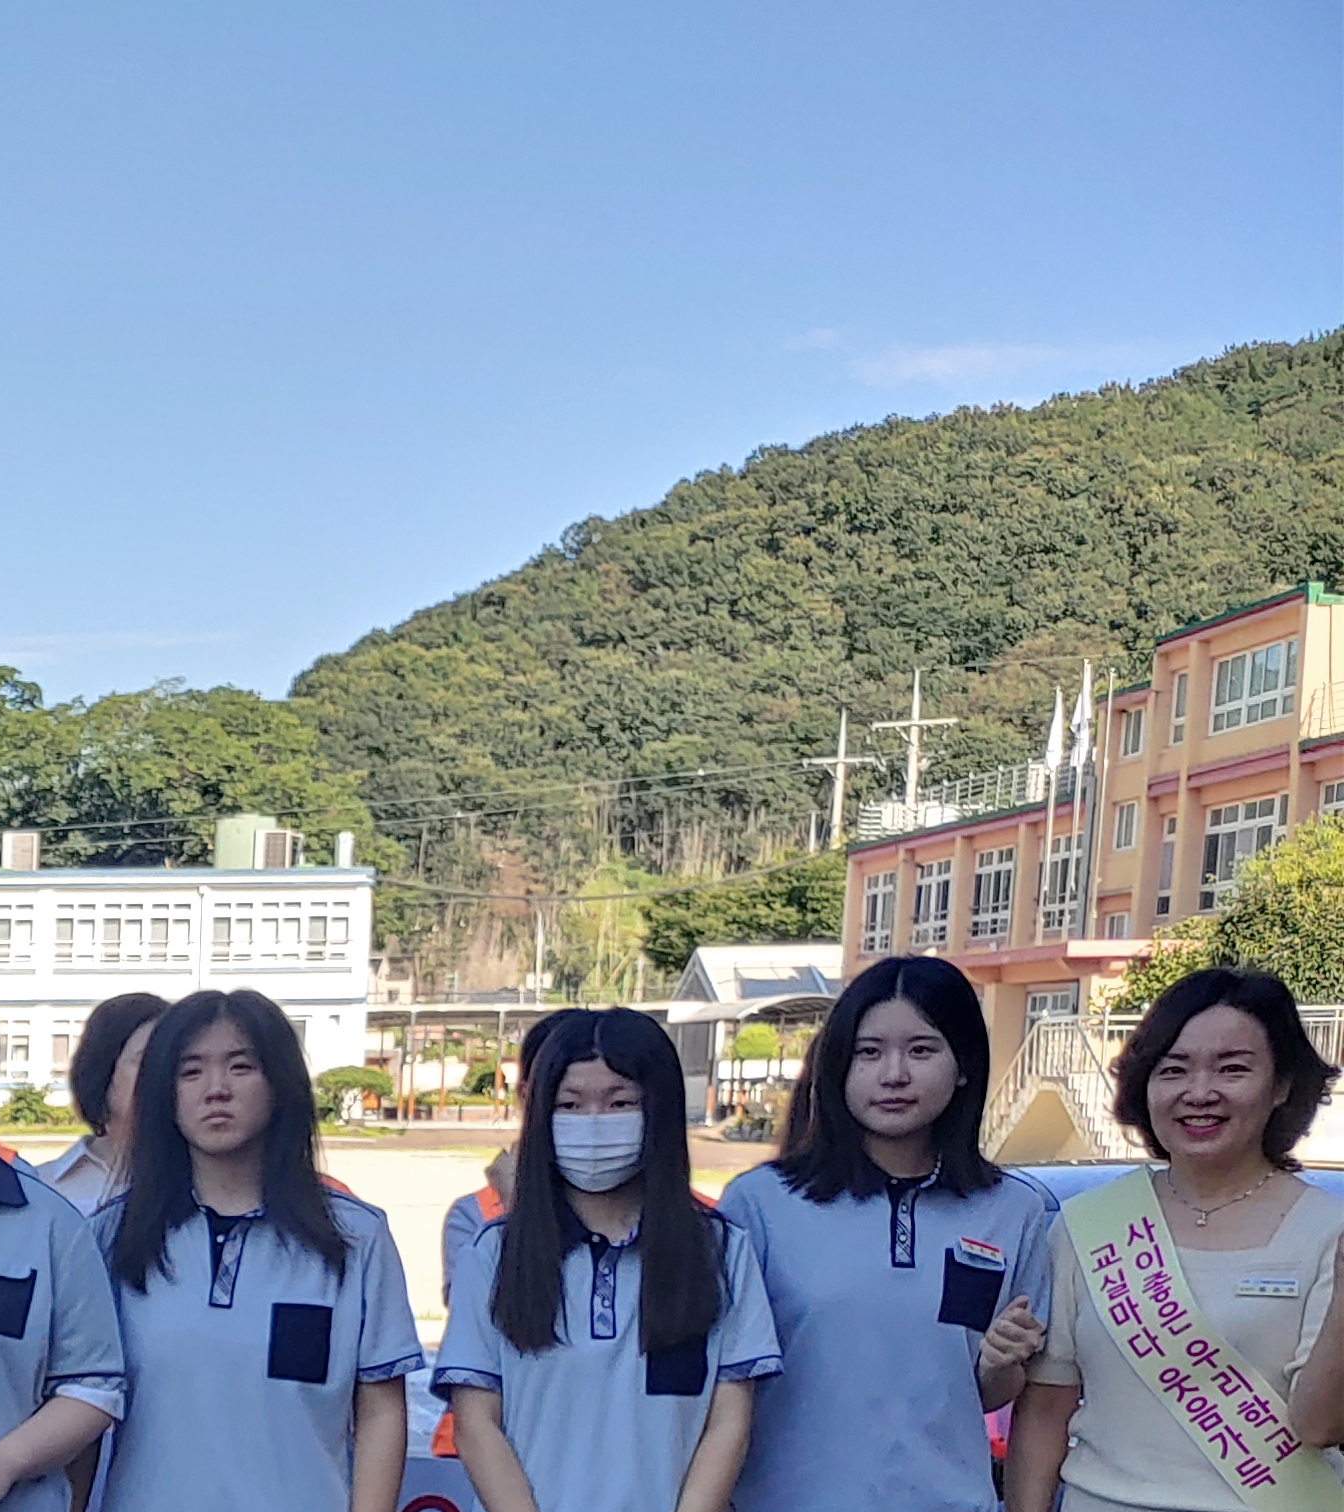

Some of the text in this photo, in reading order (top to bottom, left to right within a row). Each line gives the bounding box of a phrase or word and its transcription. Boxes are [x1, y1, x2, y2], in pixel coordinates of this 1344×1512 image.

[1090, 1242, 1166, 1359] 교실마다
[1158, 1367, 1276, 1489] 웃음가득
[1127, 1216, 1193, 1336] 사이좋은
